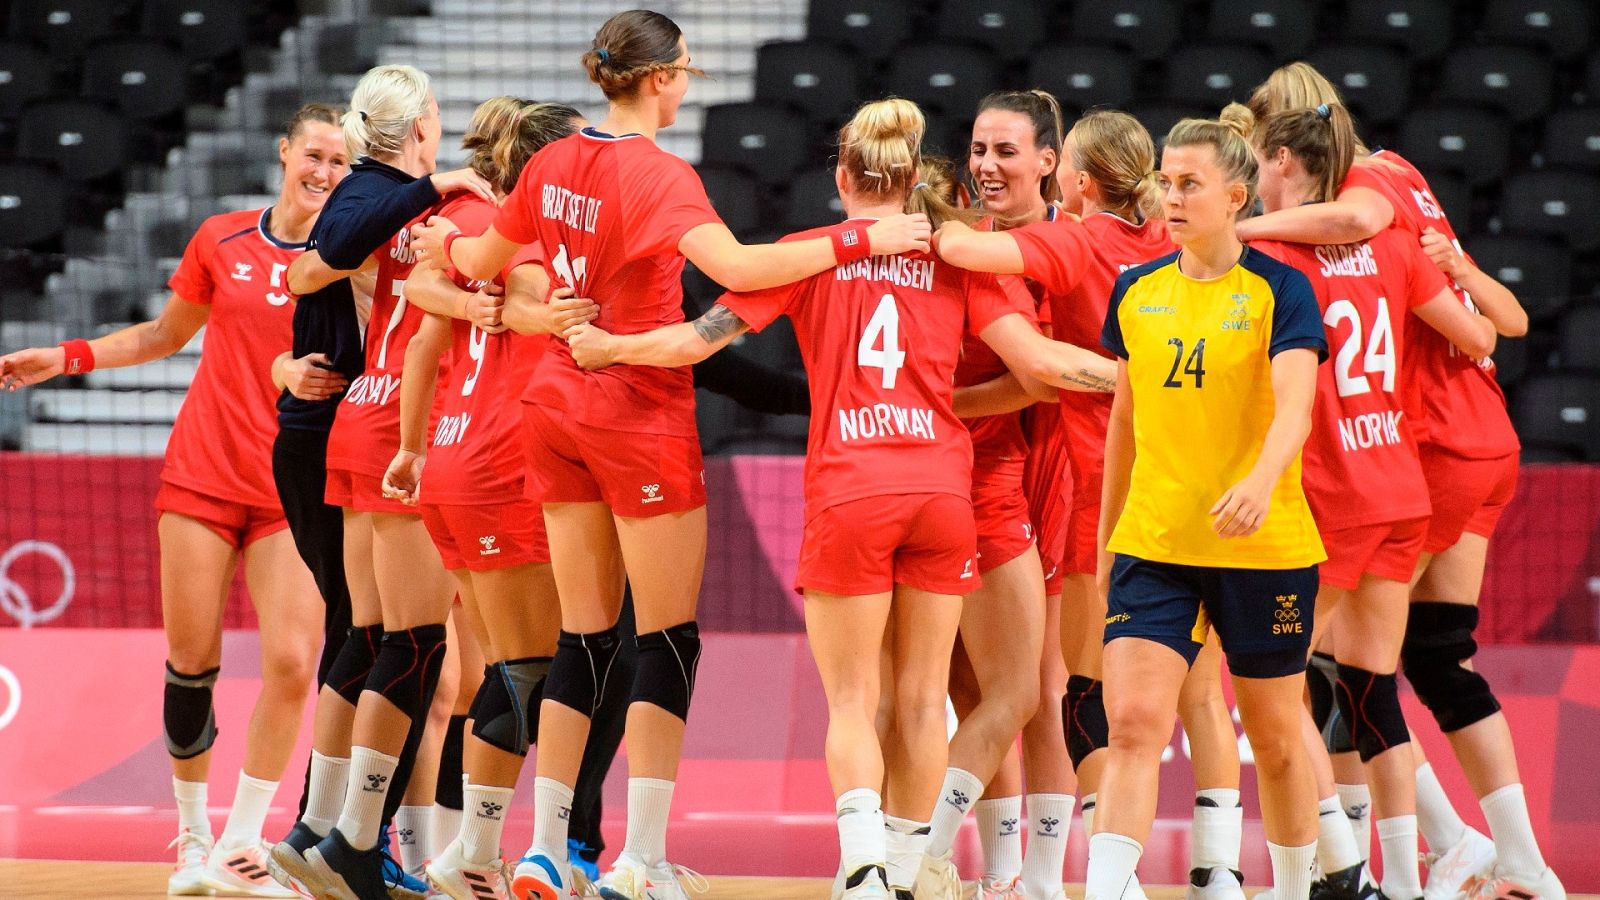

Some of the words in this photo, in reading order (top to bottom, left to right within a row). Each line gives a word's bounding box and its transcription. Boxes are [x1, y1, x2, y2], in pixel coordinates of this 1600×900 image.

[858, 293, 906, 389] 4
[1222, 320, 1251, 331] SWE
[1322, 296, 1396, 398] 24
[461, 324, 488, 396] 9
[1163, 338, 1206, 388] 24
[838, 403, 936, 441] NORWAY
[1272, 622, 1303, 635] SWE
